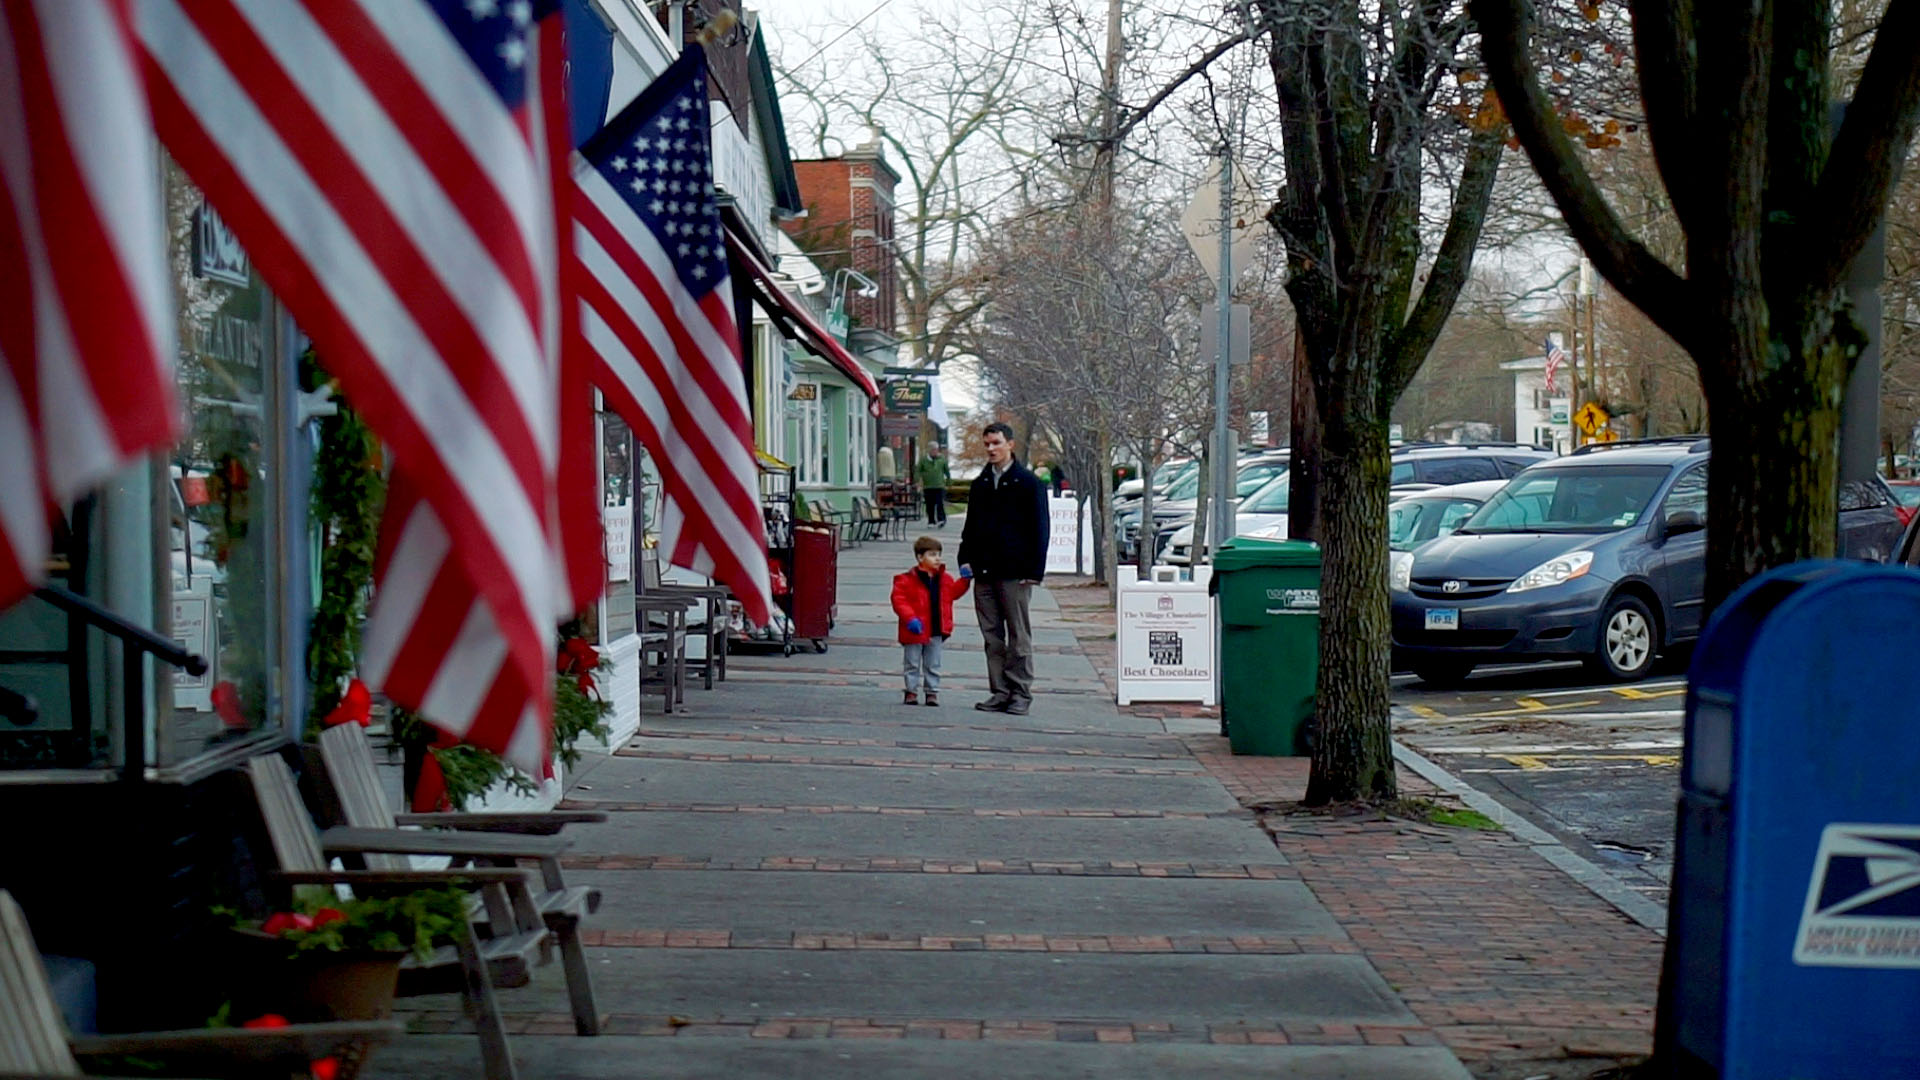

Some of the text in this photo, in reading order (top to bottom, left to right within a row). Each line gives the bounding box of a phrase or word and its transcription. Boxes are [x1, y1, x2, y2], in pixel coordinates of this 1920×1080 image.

[892, 387, 924, 400] Thai
[1051, 536, 1076, 545] REN
[1124, 611, 1137, 619] The
[1139, 611, 1165, 620] Village
[1123, 667, 1208, 677] Best Chocolates
[1808, 925, 1867, 938] UNITED
[1803, 941, 1858, 955] POSTAL
